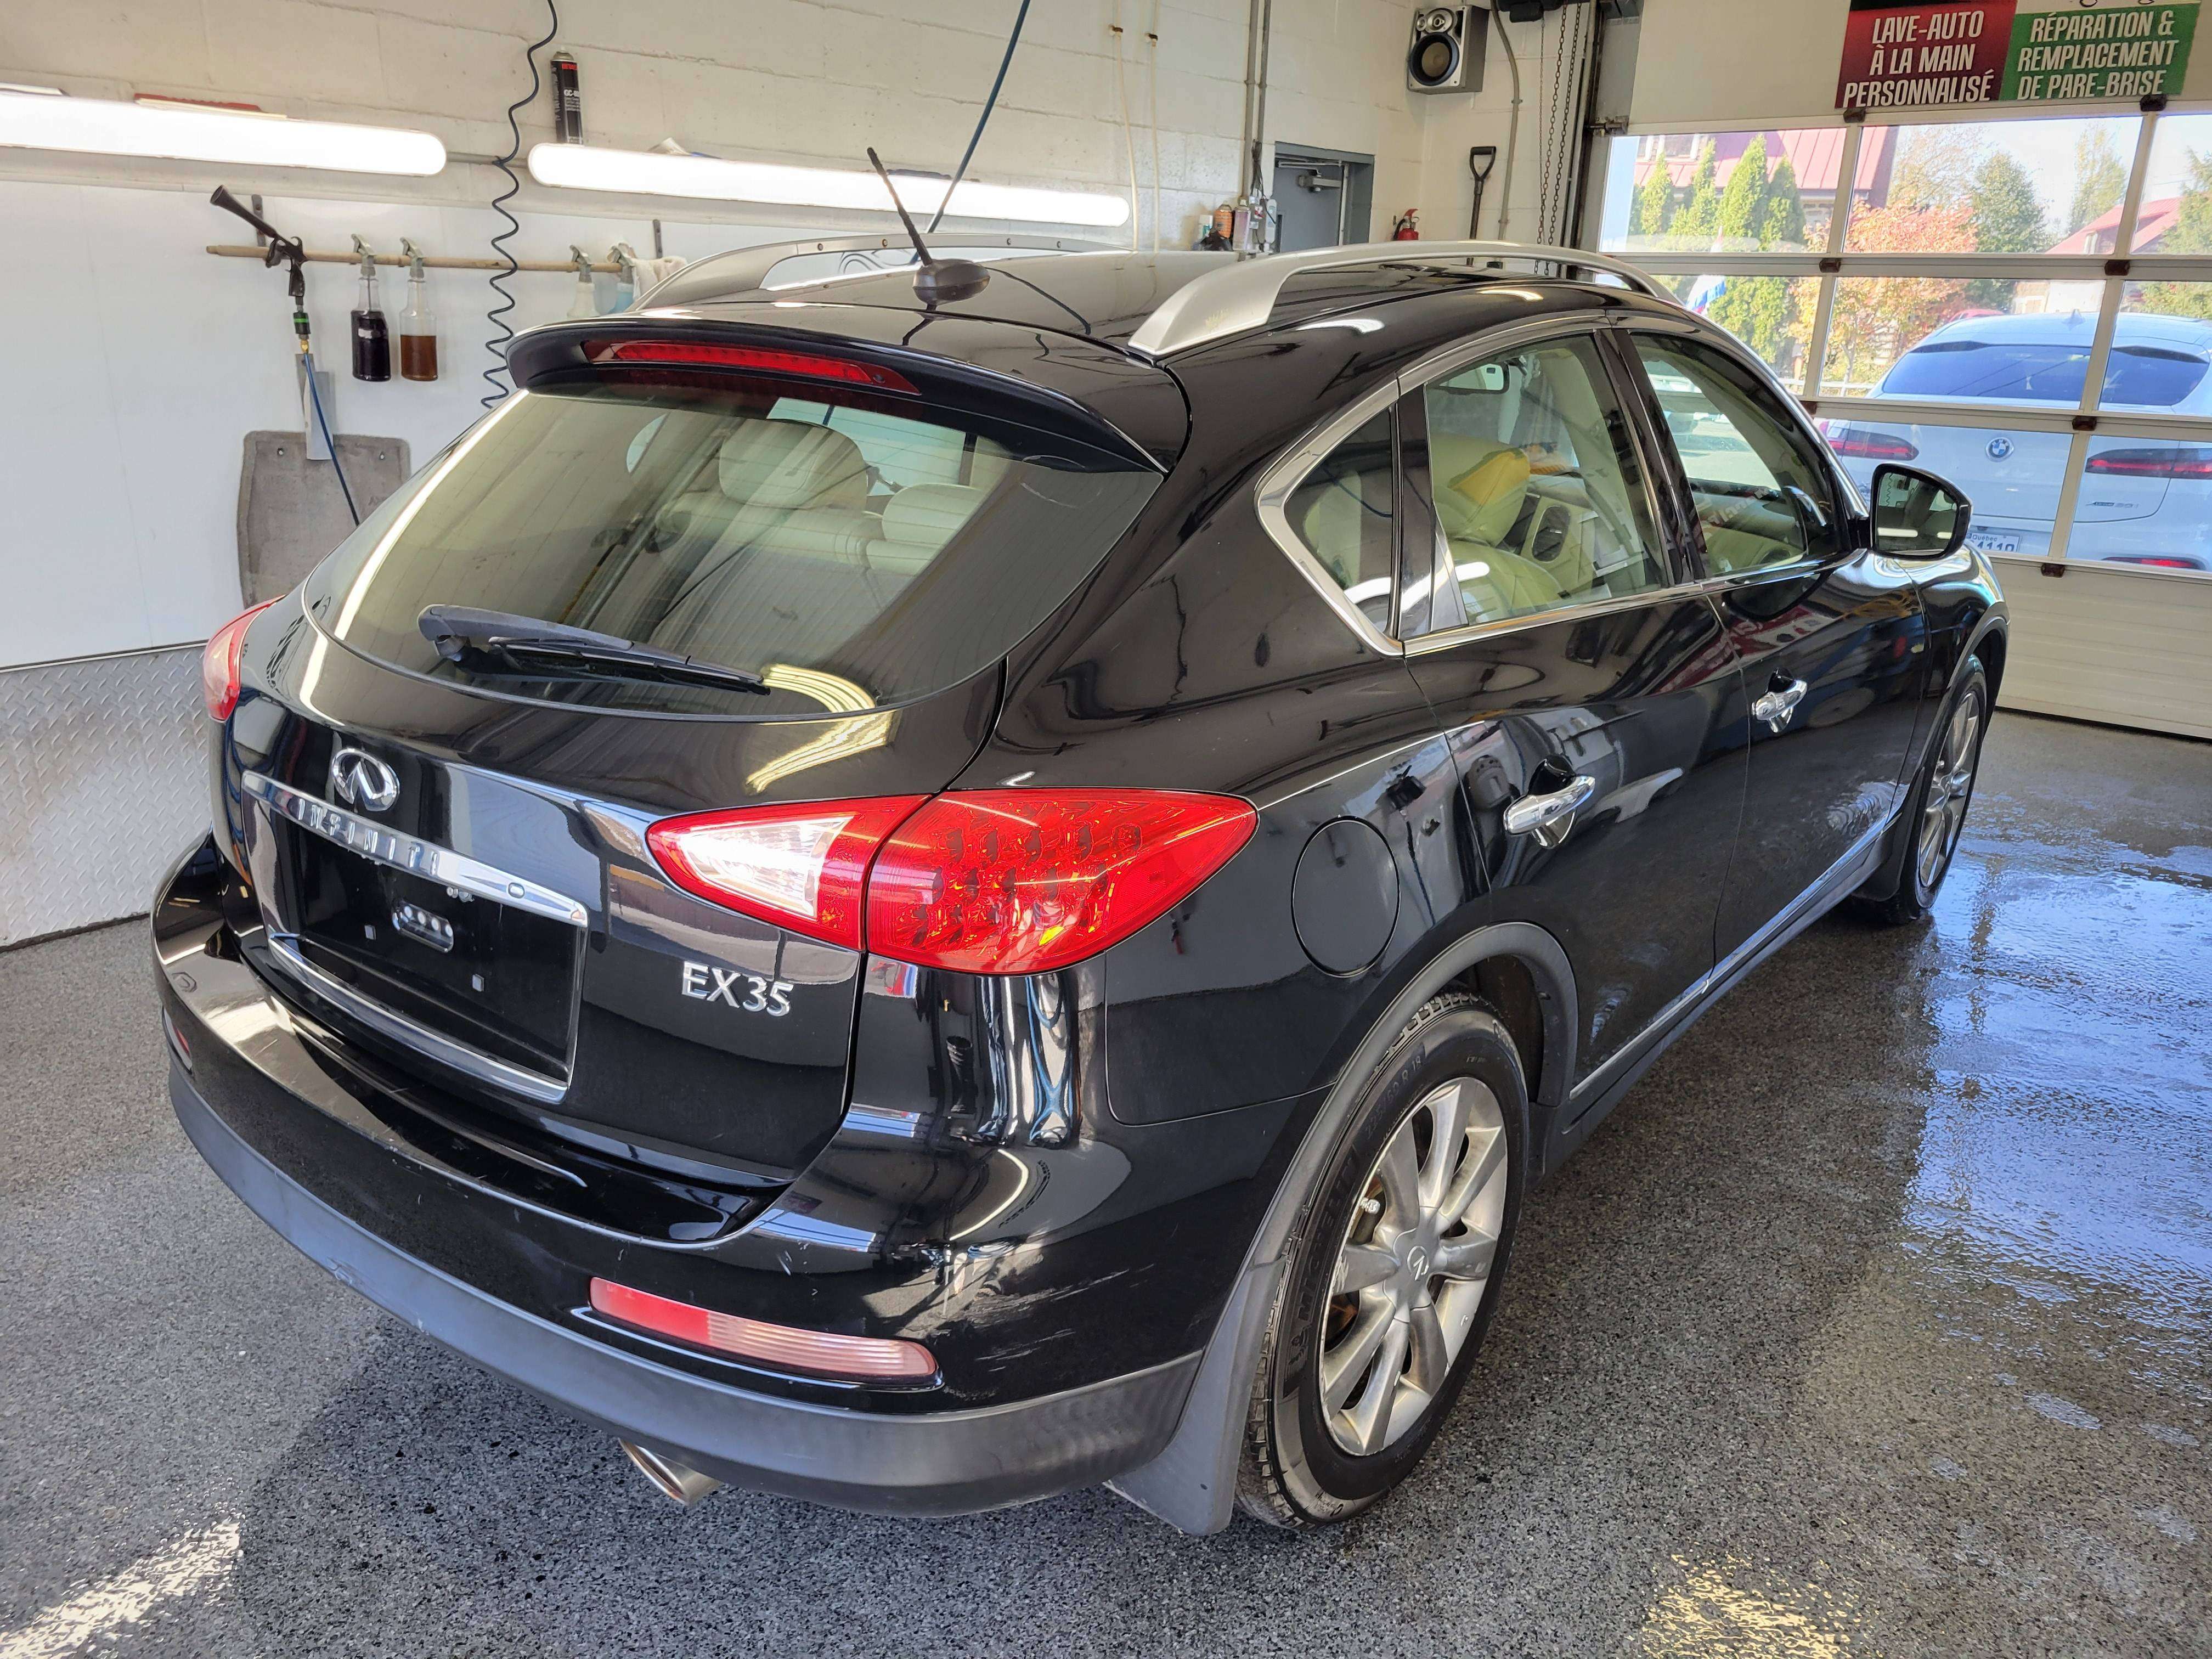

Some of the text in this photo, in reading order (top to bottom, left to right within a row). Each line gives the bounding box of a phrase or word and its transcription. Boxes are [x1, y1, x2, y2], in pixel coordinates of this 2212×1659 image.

[1872, 10, 1984, 44] LAVE-AUTO
[2030, 10, 2175, 43] RÉPARATION &
[1869, 44, 1975, 76] À LA MAIN
[2017, 40, 2179, 72] REMPLACEMENT
[1843, 69, 1994, 108] PERSONNALISÉ
[2017, 70, 2166, 100] DE PARE-BRISE
[298, 798, 439, 875] INFINITI
[682, 960, 794, 1017] EX35
